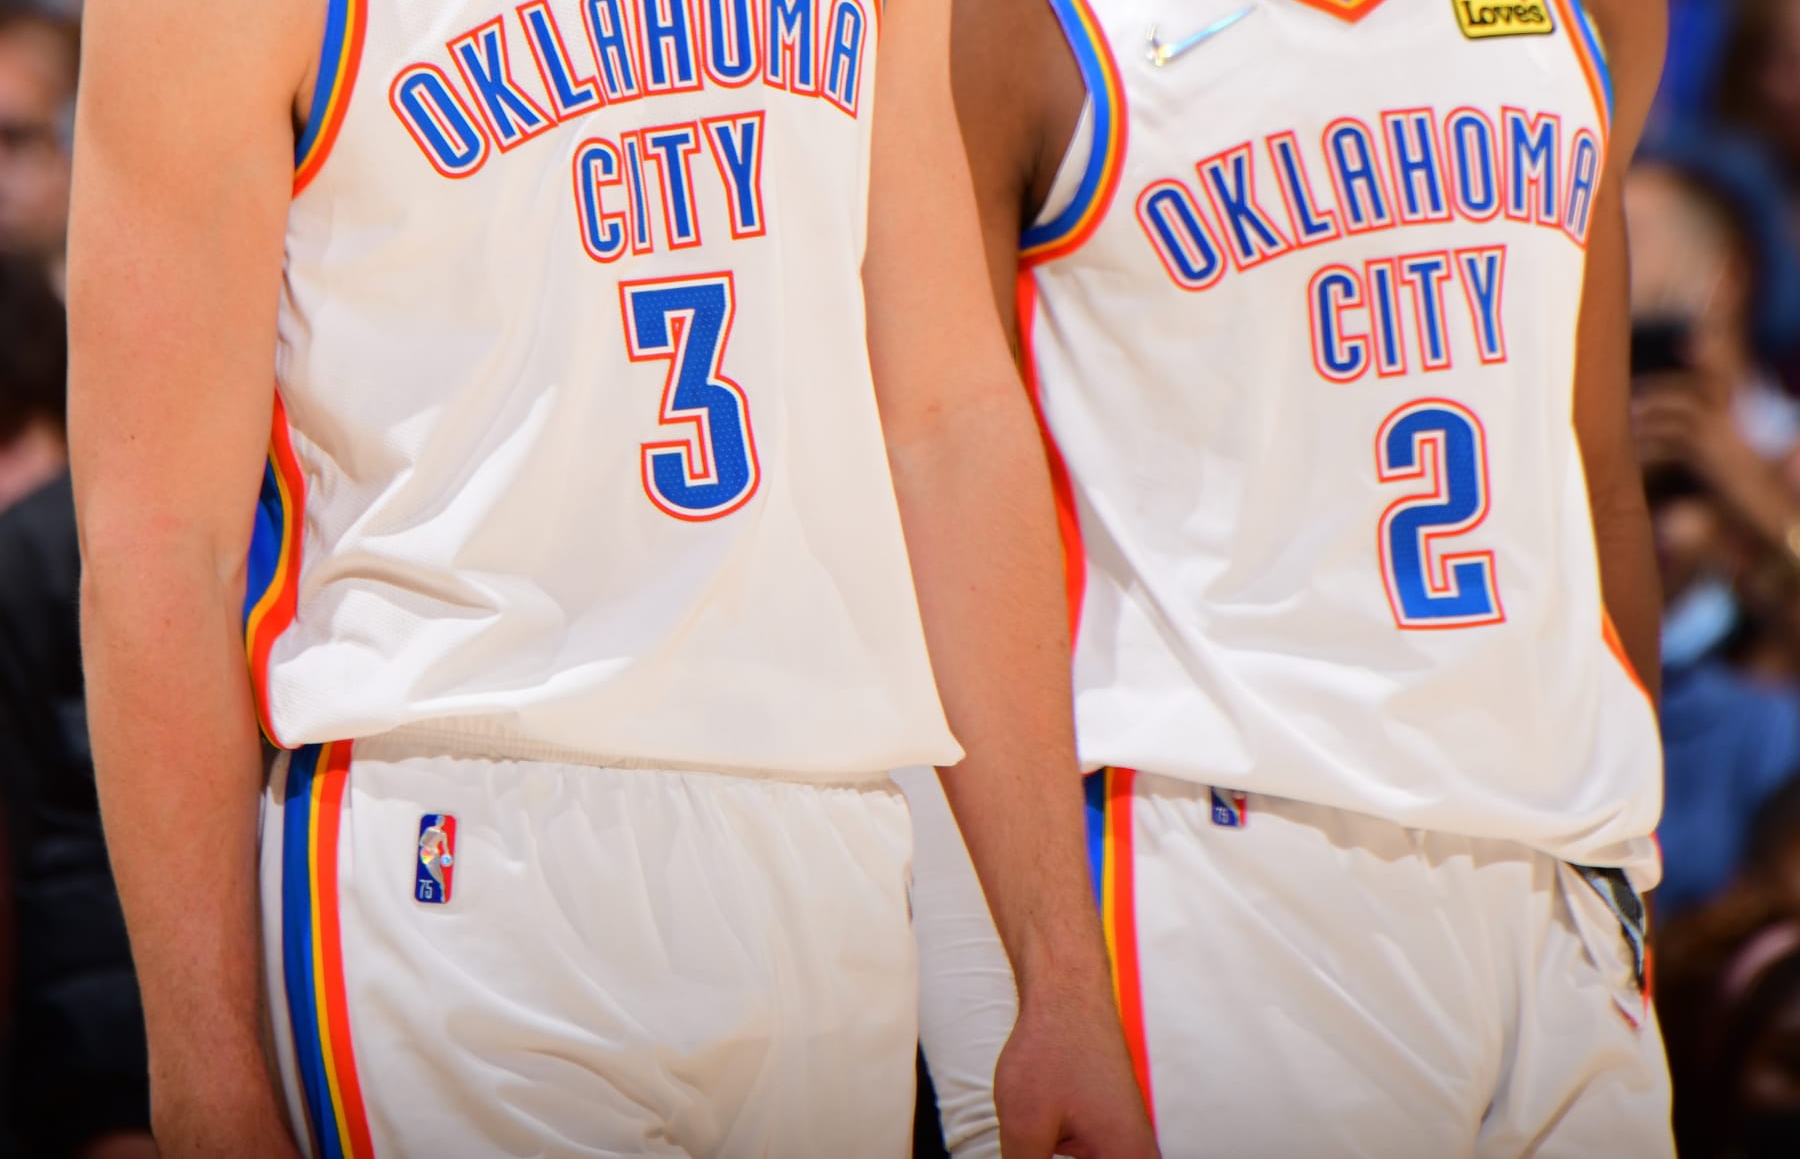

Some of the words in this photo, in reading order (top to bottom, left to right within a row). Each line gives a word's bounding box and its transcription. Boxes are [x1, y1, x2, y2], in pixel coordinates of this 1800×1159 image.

[572, 110, 767, 264] CITY
[1134, 105, 1604, 292] OKLAHOMA
[618, 270, 761, 522] 3
[1307, 244, 1507, 385] CITY
[1374, 397, 1507, 631] 2
[418, 878, 434, 900] 75
